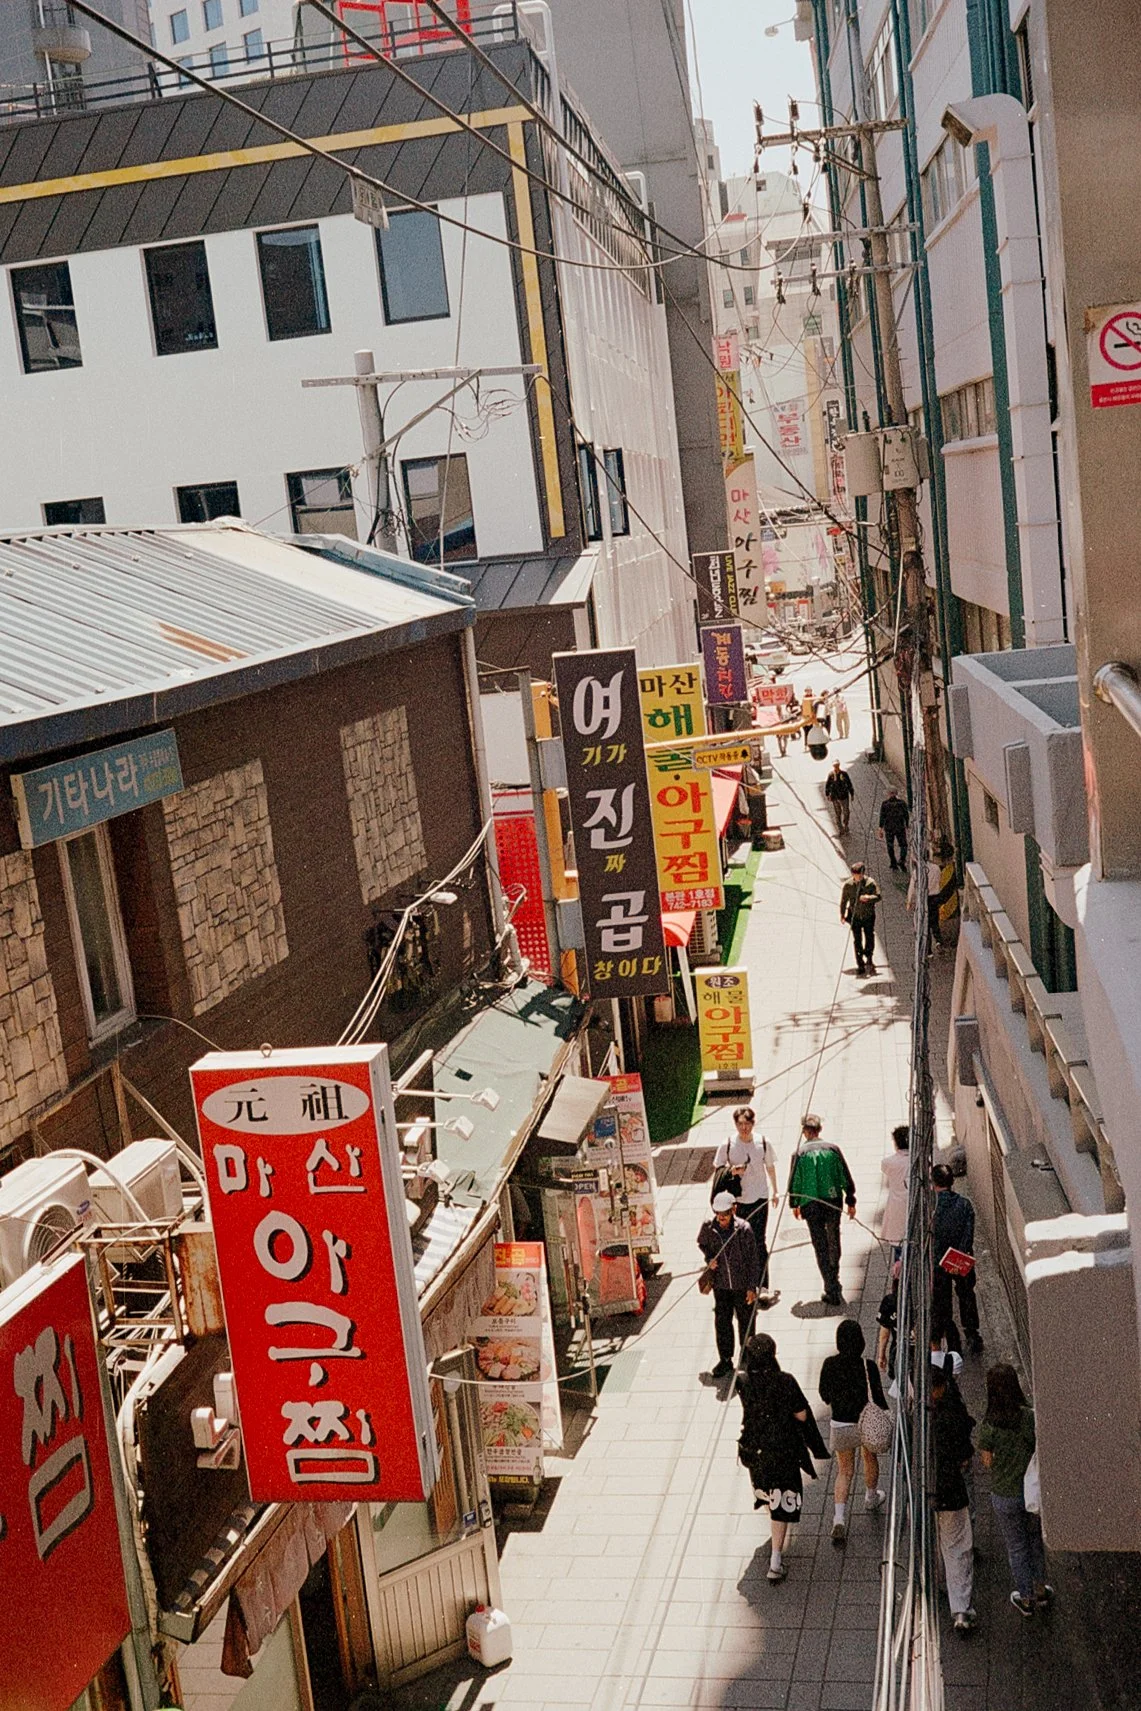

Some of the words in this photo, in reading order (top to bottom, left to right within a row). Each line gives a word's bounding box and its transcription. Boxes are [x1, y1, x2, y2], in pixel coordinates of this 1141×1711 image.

[730, 488, 751, 525] 마산
[727, 573, 737, 592] JAZZ
[735, 531, 759, 606] 아구찜
[640, 671, 698, 698] 마산
[696, 754, 718, 764] CCTV
[38, 753, 139, 825] 기타나라
[656, 782, 712, 885] 아구찜
[702, 989, 744, 1004] 해물
[708, 975, 739, 989] 원조
[704, 1005, 748, 1062] 아구찜
[224, 1083, 349, 1124] 元祖
[213, 1138, 367, 1197] 마산
[252, 1210, 380, 1486] 아구찜
[12, 1325, 95, 1562] 찜
